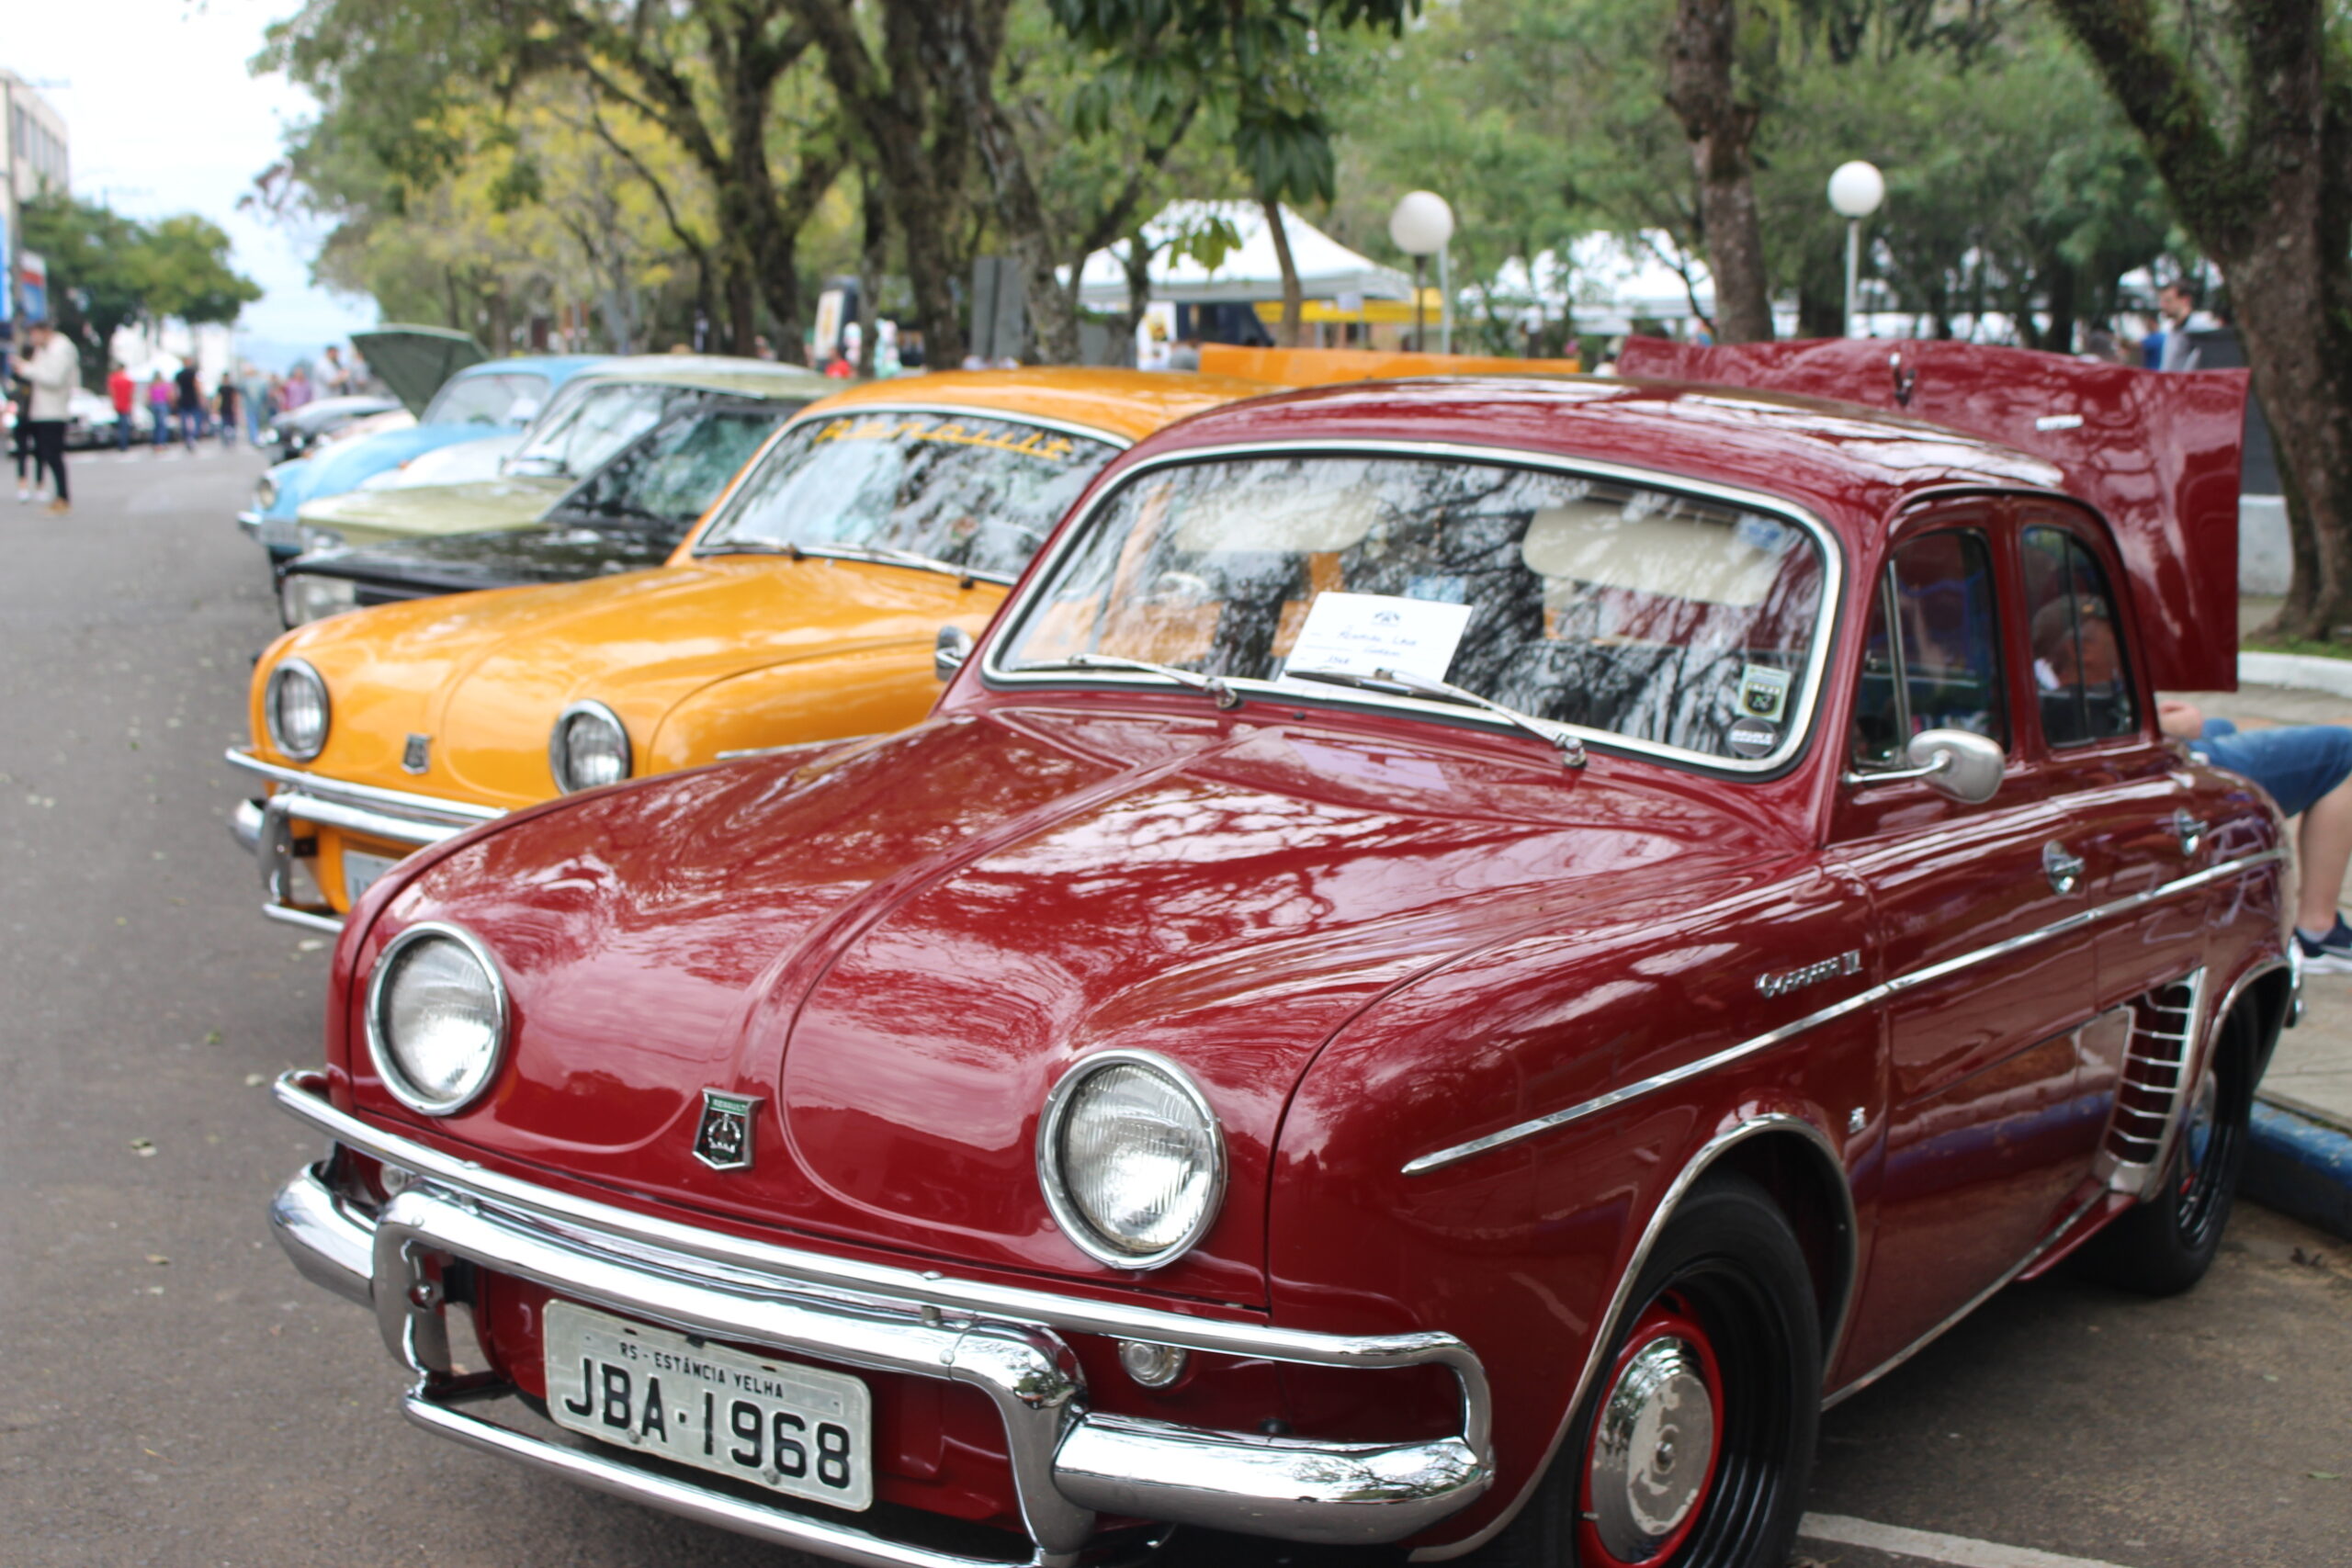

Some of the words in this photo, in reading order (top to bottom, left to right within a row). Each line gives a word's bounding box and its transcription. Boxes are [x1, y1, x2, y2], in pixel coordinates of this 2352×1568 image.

[814, 419, 1073, 460] Renault
[618, 1342, 639, 1359] RS
[655, 1351, 726, 1383] ESTÂNCIA
[734, 1373, 784, 1399] VELHA
